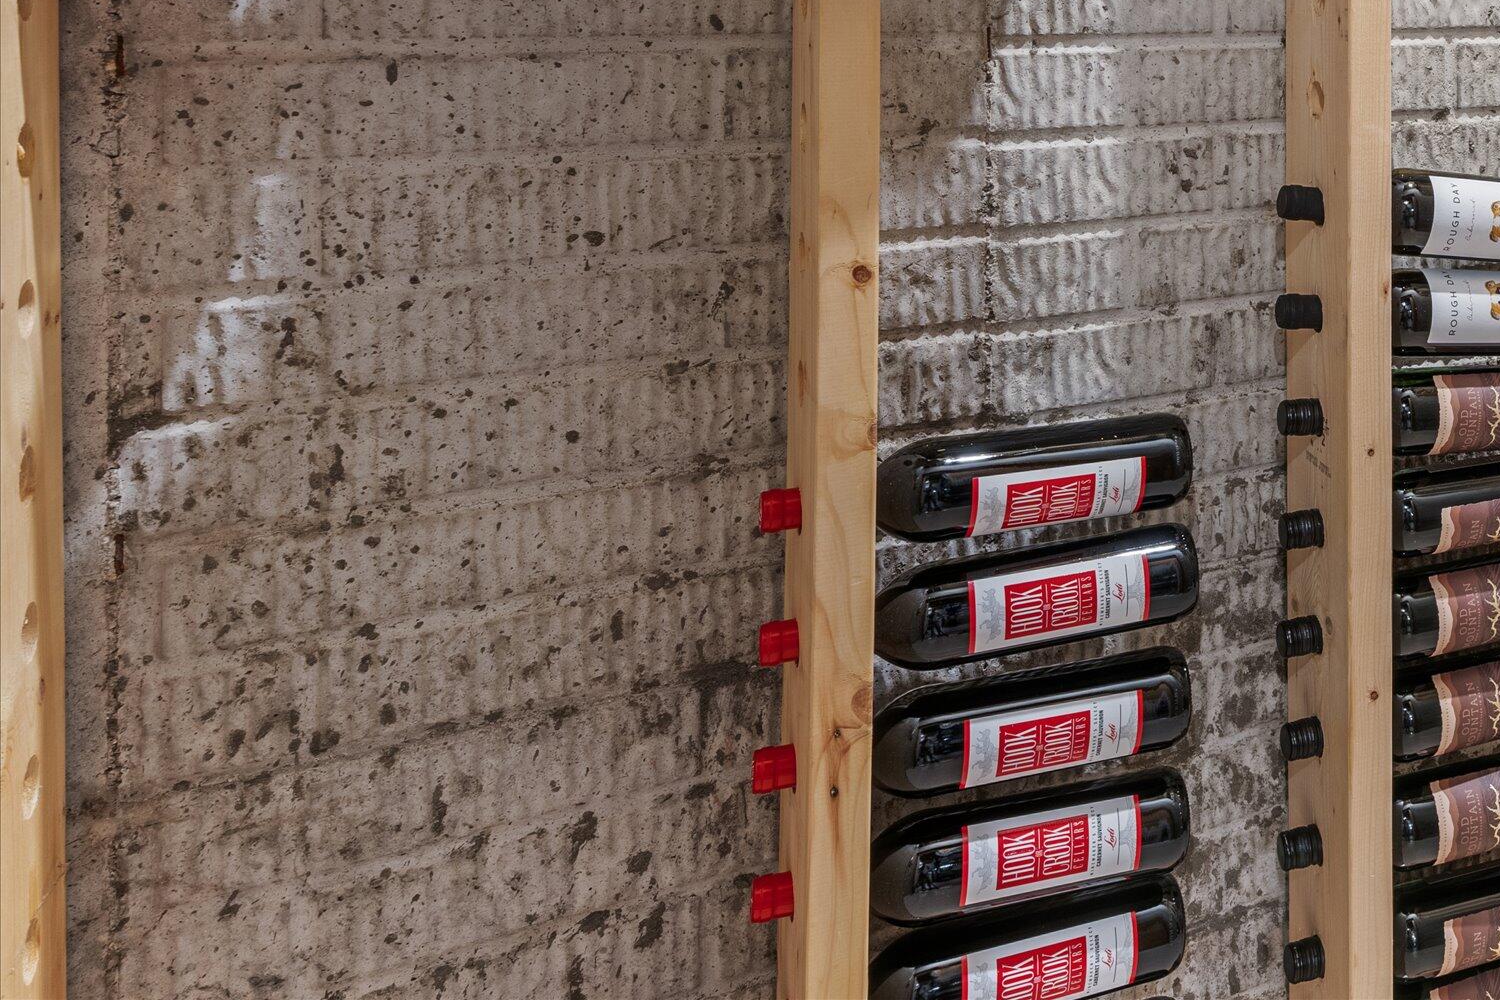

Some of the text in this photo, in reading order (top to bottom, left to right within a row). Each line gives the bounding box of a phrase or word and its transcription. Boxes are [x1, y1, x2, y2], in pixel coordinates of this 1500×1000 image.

[1453, 183, 1461, 204] DAY
[1448, 291, 1460, 336] ROUGH
[1459, 409, 1469, 436] OLD
[1006, 486, 1043, 528] HOOK
[1046, 482, 1077, 523] CROOK
[1109, 486, 1120, 504] Lodi
[1010, 585, 1043, 634] HOOK
[1050, 579, 1078, 627] CROOK
[1081, 576, 1091, 621] CELLARS
[1113, 583, 1123, 605] Lodi
[1459, 608, 1469, 636] OLD
[1042, 719, 1073, 765] CROOK
[1072, 715, 1086, 760] CELLARS
[1105, 723, 1117, 744] Lodi
[1461, 708, 1471, 736] OLD
[1001, 725, 1037, 774] HOOK
[1042, 823, 1071, 877] CROOK
[1072, 820, 1084, 869] CELLARS
[1104, 827, 1117, 850] Lodi
[1460, 817, 1470, 845] OLD
[1002, 830, 1036, 884] HOOK
[1040, 947, 1069, 999] CROOK
[1071, 942, 1083, 990] CELLARS
[1102, 947, 1114, 969] Lodi
